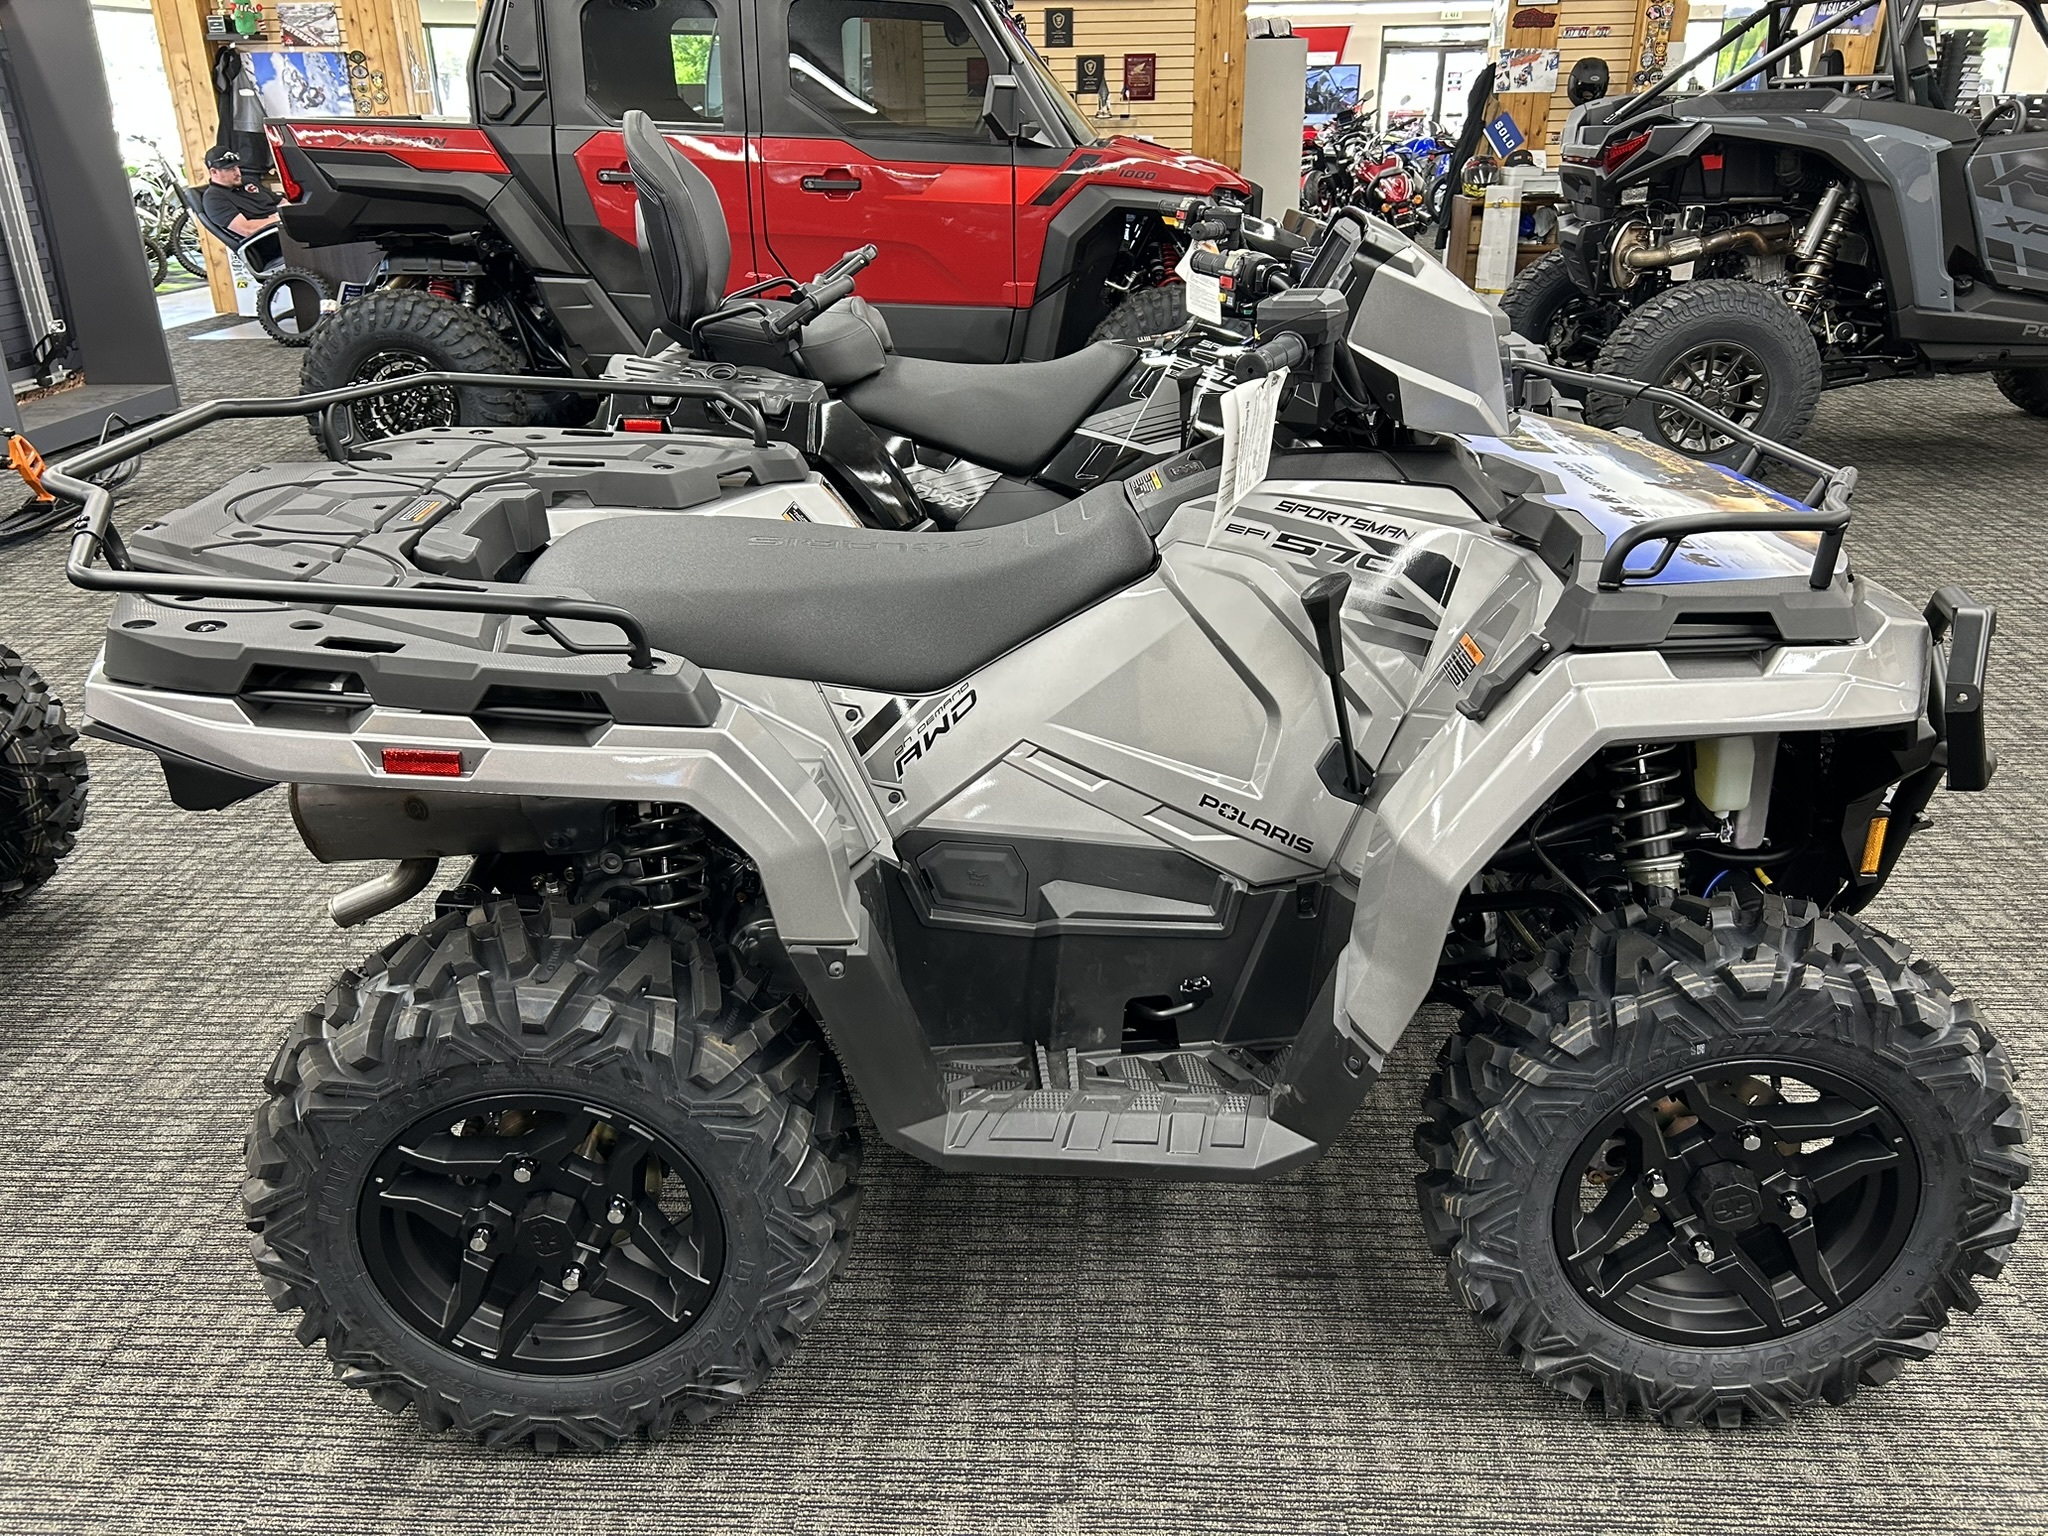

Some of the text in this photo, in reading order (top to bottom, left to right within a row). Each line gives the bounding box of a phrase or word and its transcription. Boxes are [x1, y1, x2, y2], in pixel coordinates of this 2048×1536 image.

[1495, 121, 1515, 149] SOLD
[1119, 170, 1157, 180] 1000
[1274, 500, 1417, 541] SPORTSMAN
[1225, 523, 1406, 579] EFI 570
[894, 681, 970, 756] ON DEMAND
[895, 688, 977, 778] AWD
[1198, 793, 1315, 854] POLARIS
[610, 1294, 745, 1403] DURO
[1666, 1333, 1841, 1379] DURO
